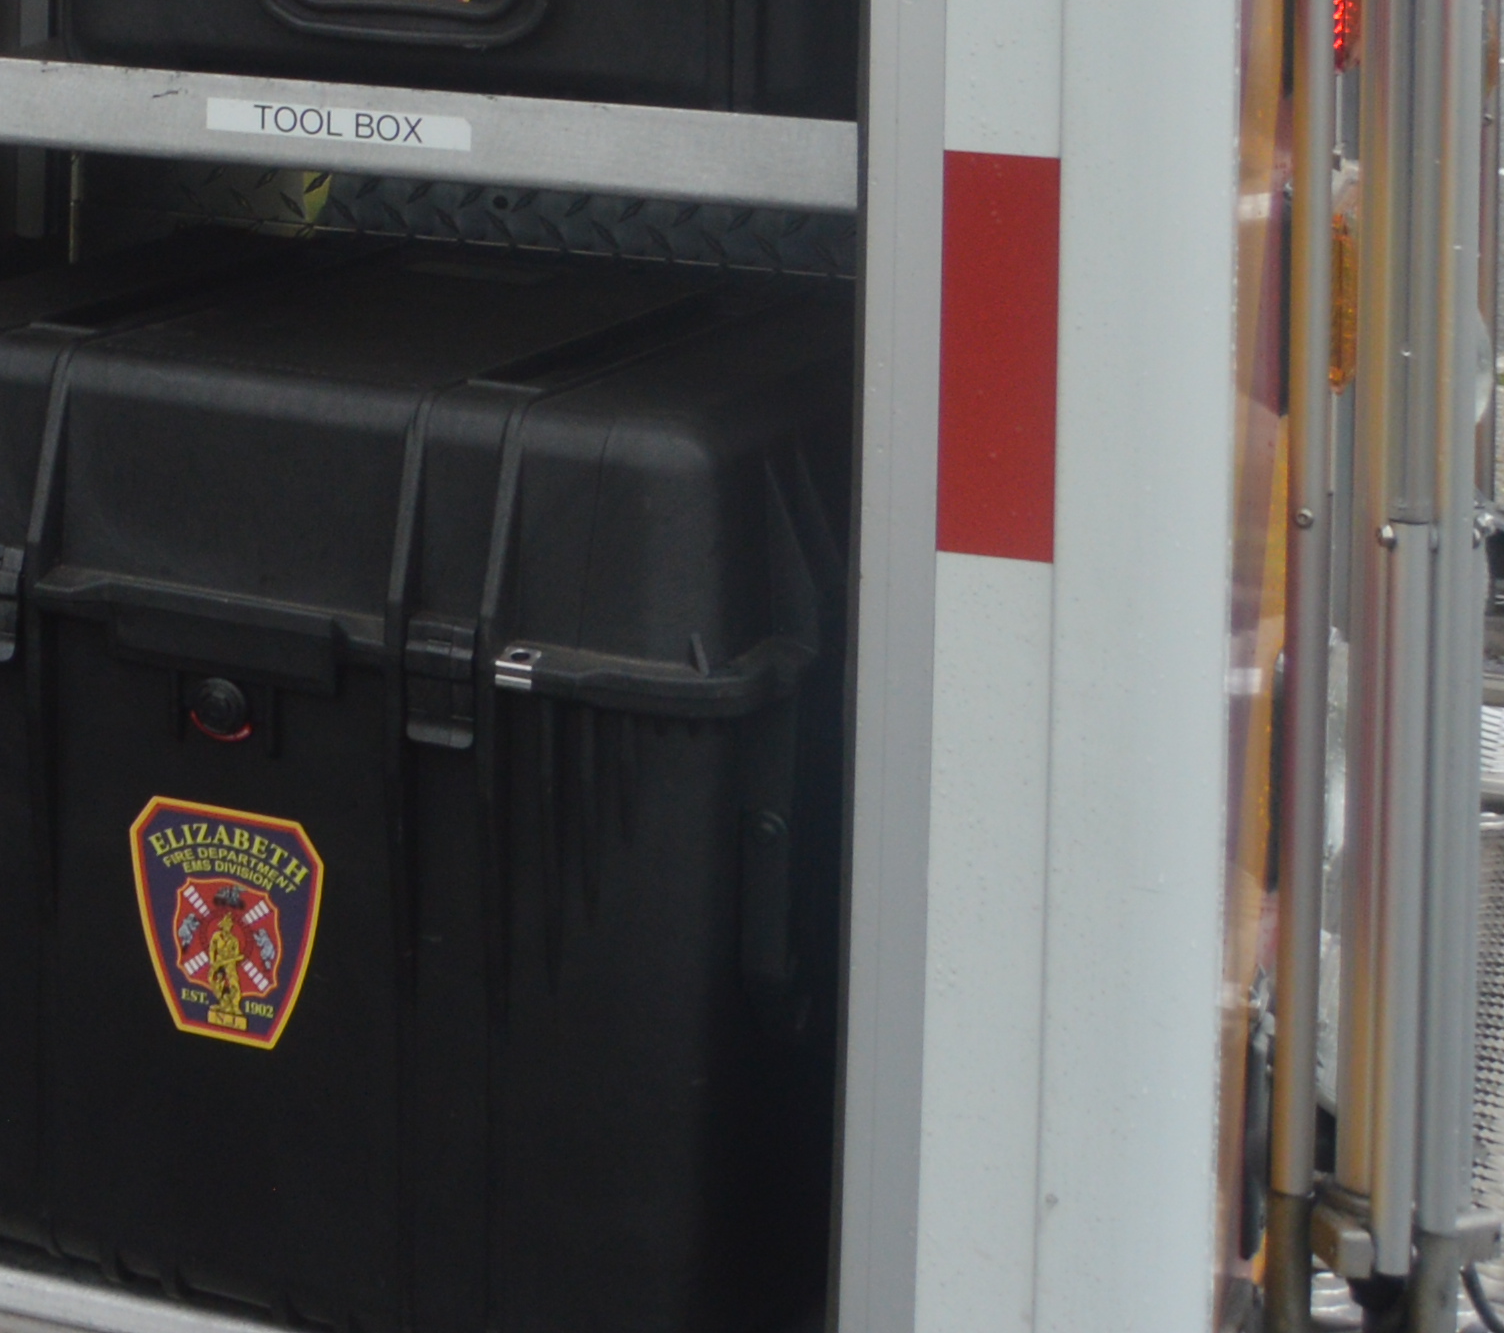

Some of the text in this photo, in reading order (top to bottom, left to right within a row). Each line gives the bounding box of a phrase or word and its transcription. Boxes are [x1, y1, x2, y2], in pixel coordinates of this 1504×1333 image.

[254, 104, 423, 143] TOOL BOX
[148, 823, 311, 886] ELIZABETH
[162, 847, 297, 894] FIRE DEPARTMENT
[183, 859, 274, 891] EMS DIVISION
[181, 988, 274, 1019] EST. 1902
